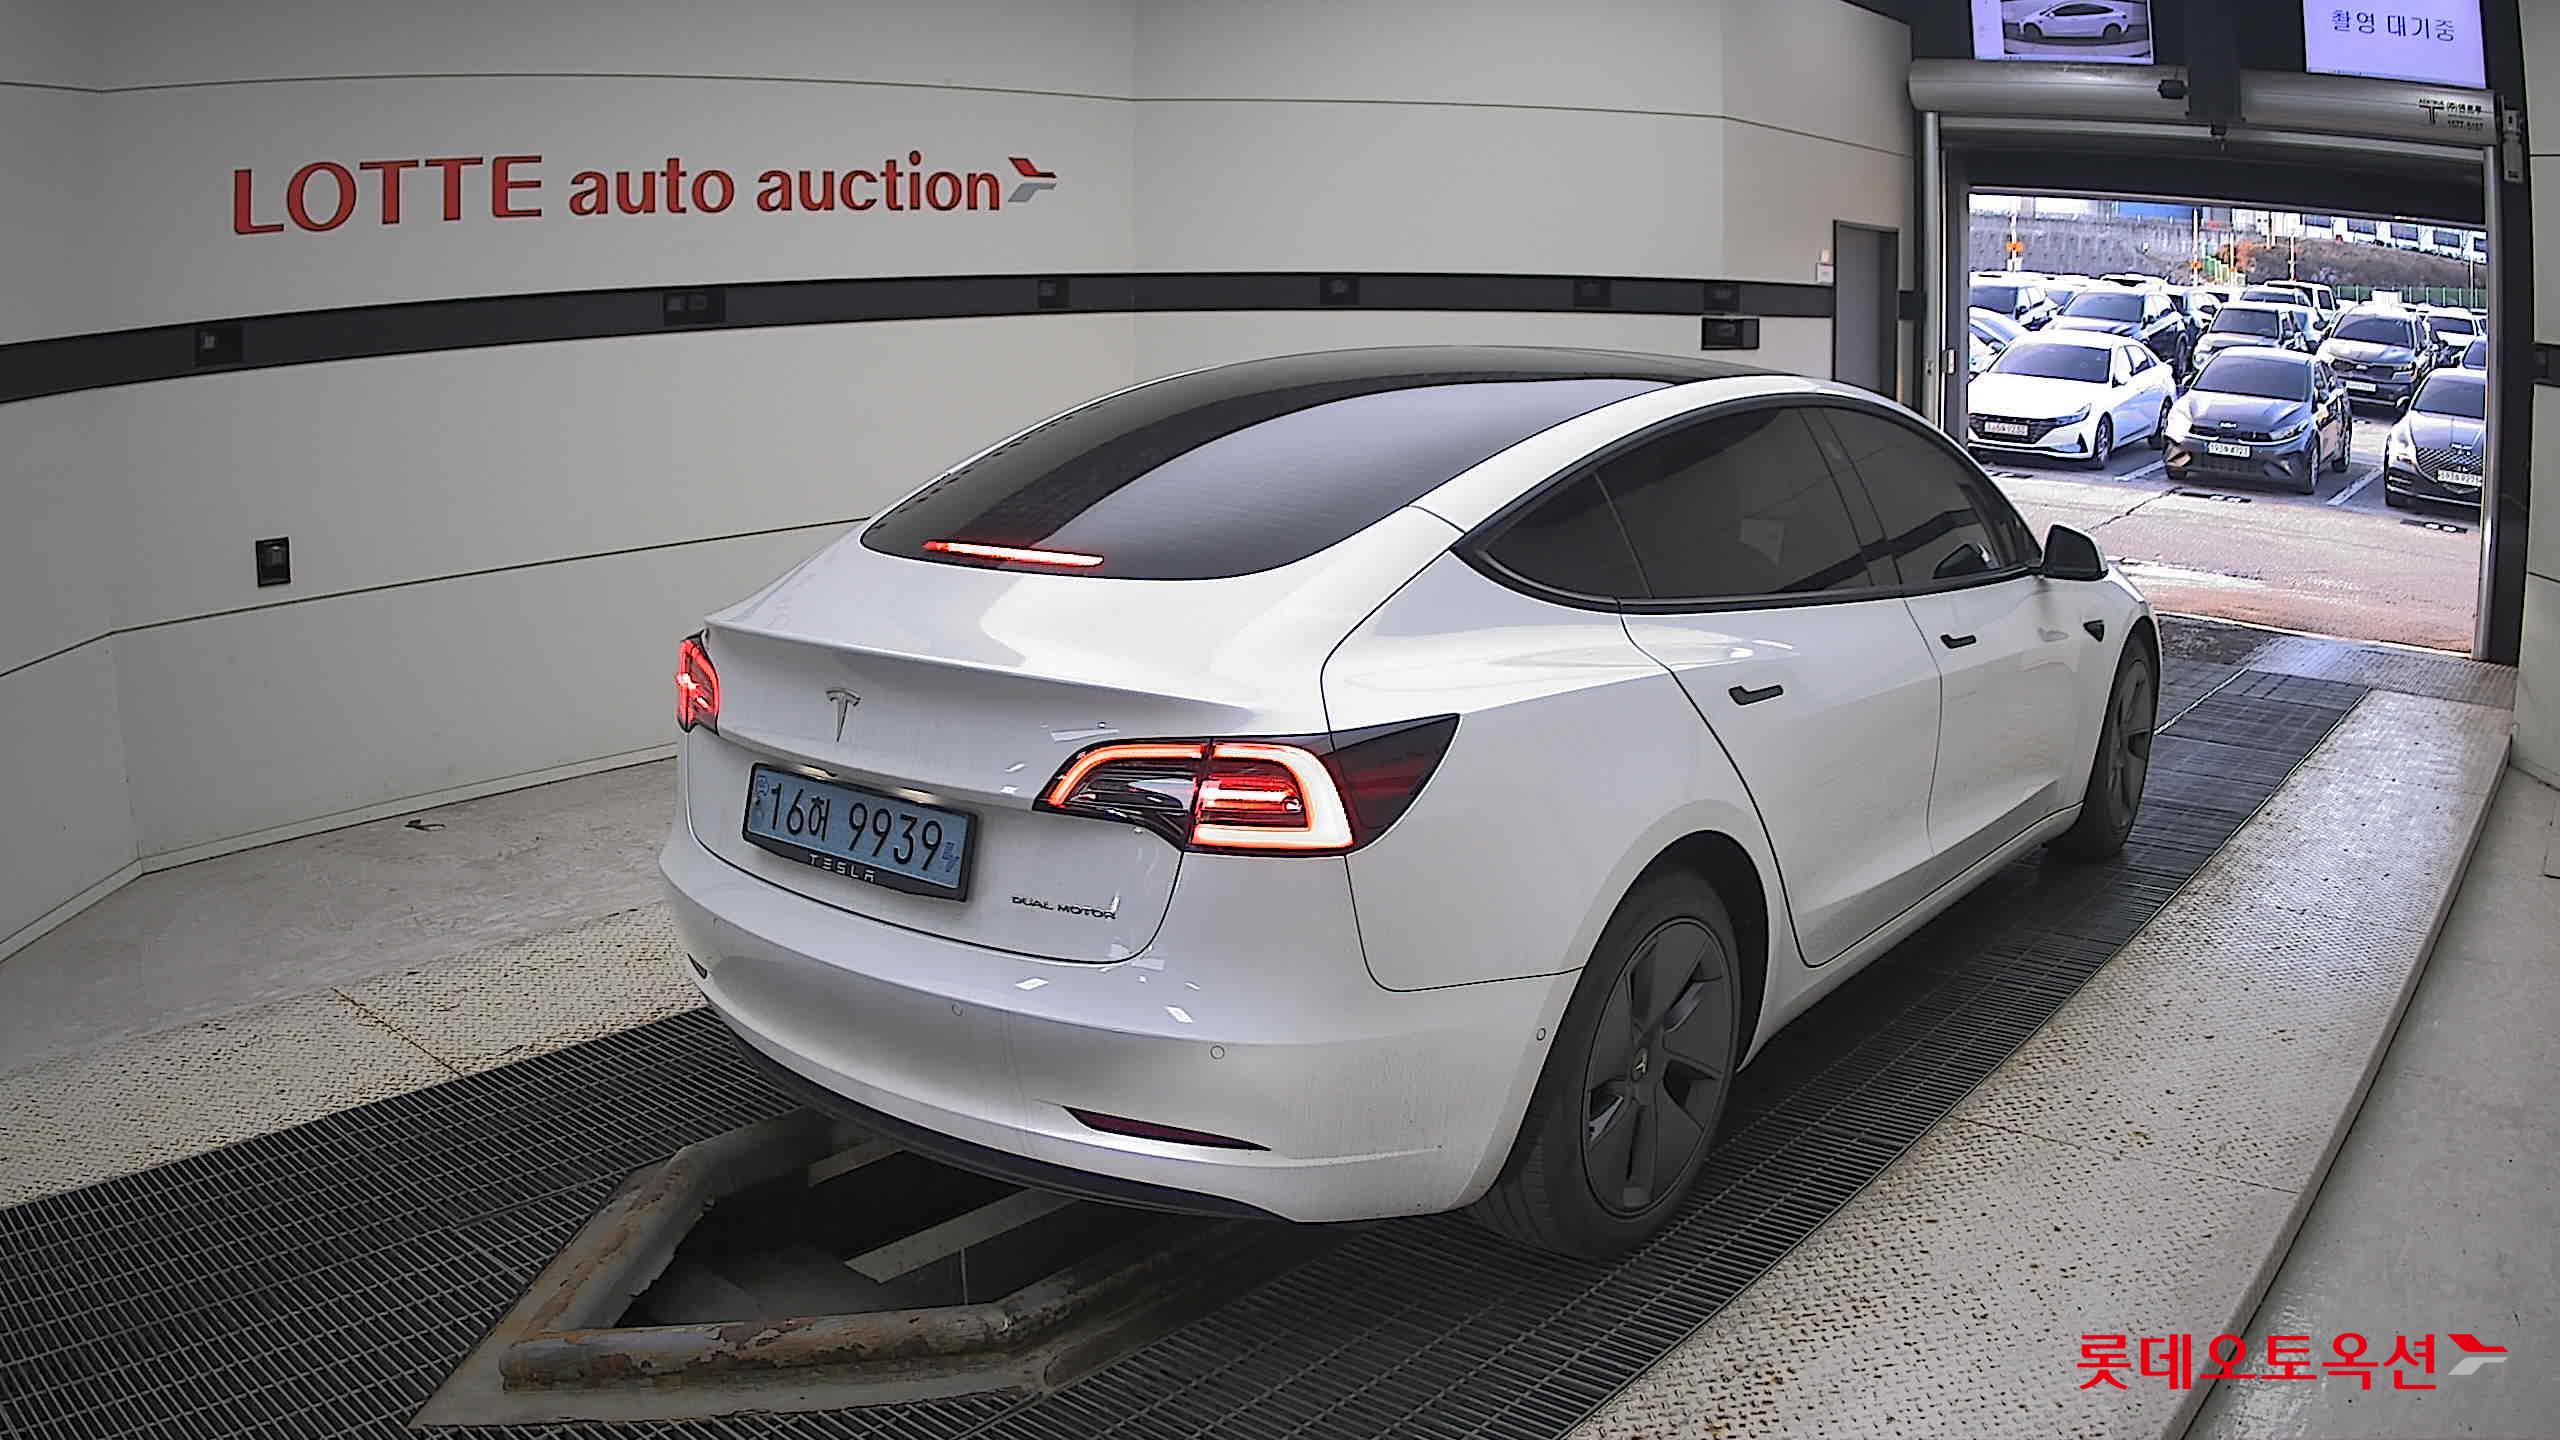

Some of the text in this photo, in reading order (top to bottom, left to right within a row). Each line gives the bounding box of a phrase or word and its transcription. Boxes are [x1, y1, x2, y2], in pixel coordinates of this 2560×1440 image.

[2331, 9, 2455, 42] 촬영 대기중
[233, 150, 1002, 235] LOTTE auto auction
[770, 783, 831, 841] 16허
[848, 802, 943, 871] 9939
[808, 853, 877, 883] TESLA
[1011, 896, 1117, 920] DUAL MOTOR
